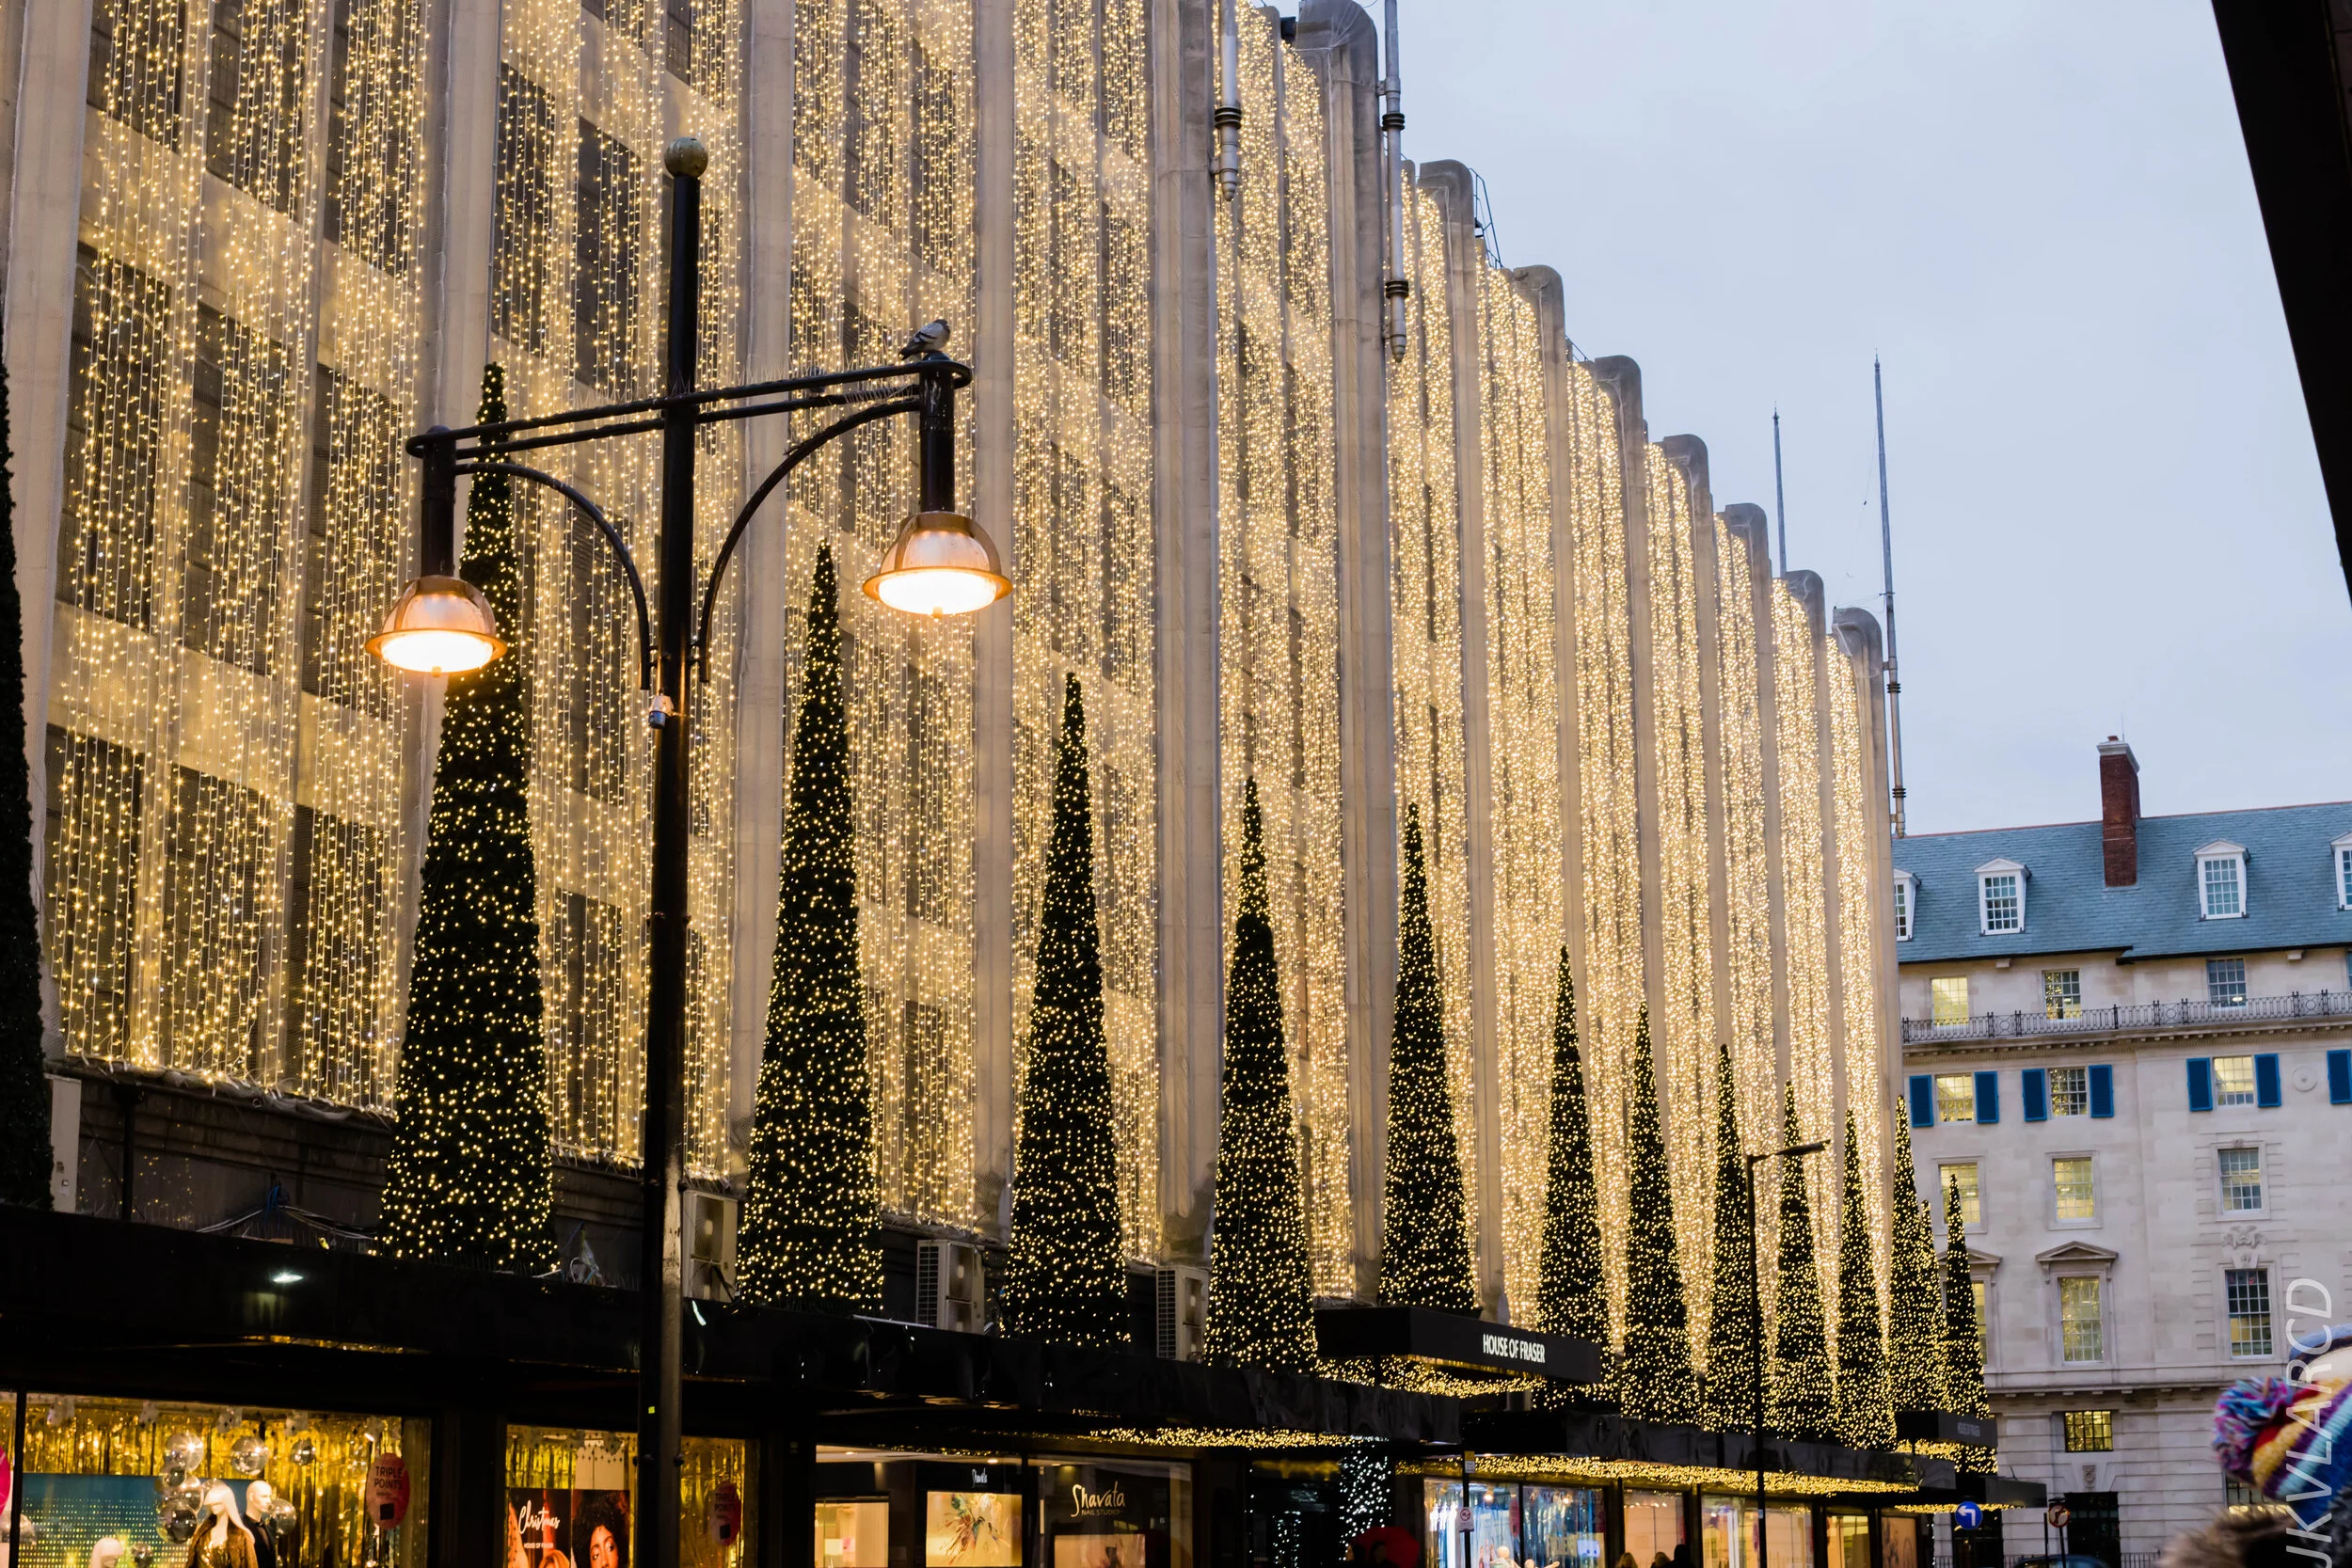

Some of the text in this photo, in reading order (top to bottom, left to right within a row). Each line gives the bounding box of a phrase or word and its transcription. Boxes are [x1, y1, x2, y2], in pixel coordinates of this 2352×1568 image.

[1483, 1334, 1546, 1363] HOUSE OF FRASER
[373, 1479, 403, 1490] POINTS
[375, 1466, 404, 1479] TRIPLE
[1071, 1481, 1126, 1517] Shavata
[518, 1499, 561, 1535] Christmas
